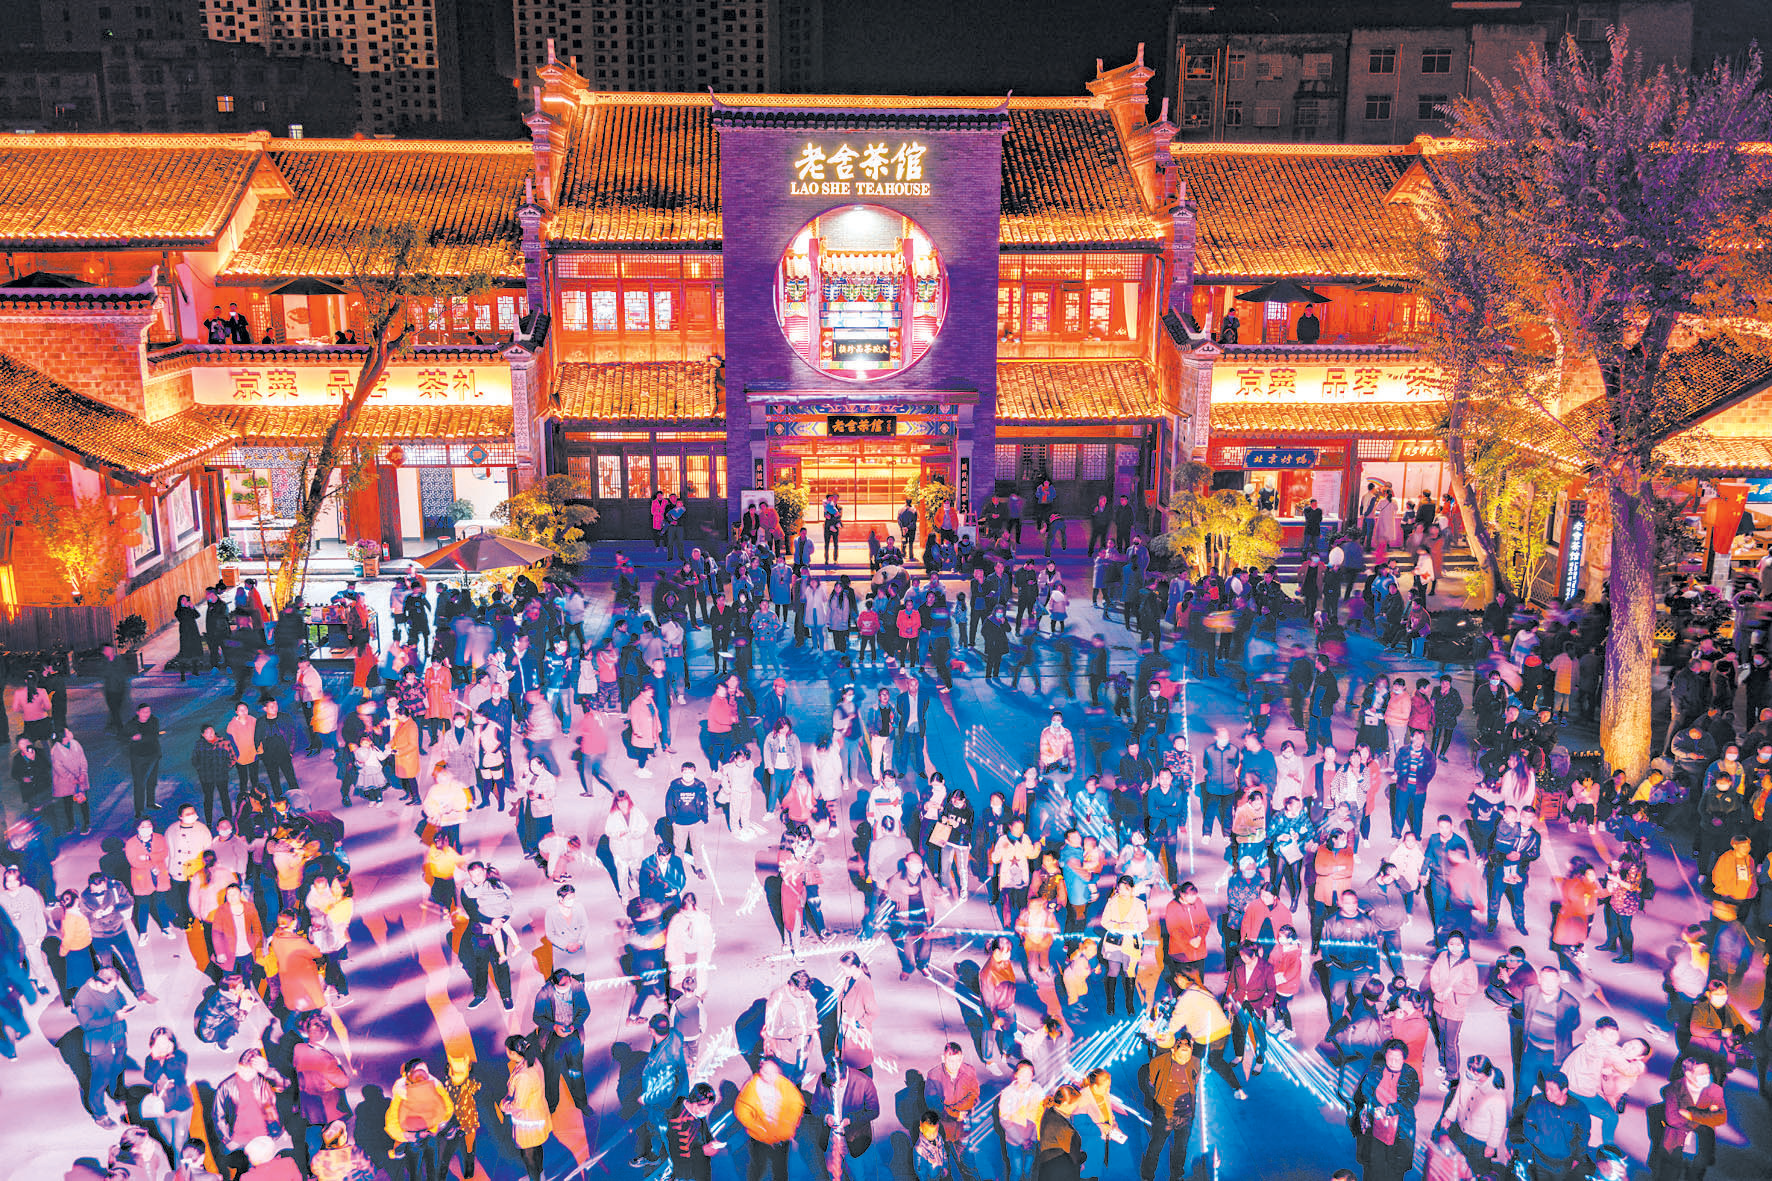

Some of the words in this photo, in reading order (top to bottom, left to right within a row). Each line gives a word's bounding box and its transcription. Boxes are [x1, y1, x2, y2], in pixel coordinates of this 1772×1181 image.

[794, 141, 928, 181] 老舍茶馆
[790, 182, 819, 196] LAO
[821, 182, 851, 196] SHE
[855, 182, 931, 197] TEAHOUSE
[230, 368, 299, 402] 京菜
[417, 368, 484, 402] 茶礼
[1235, 367, 1298, 398] 京菜
[1321, 367, 1383, 399] 品茗
[1253, 453, 1308, 465] 北京烤鸭
